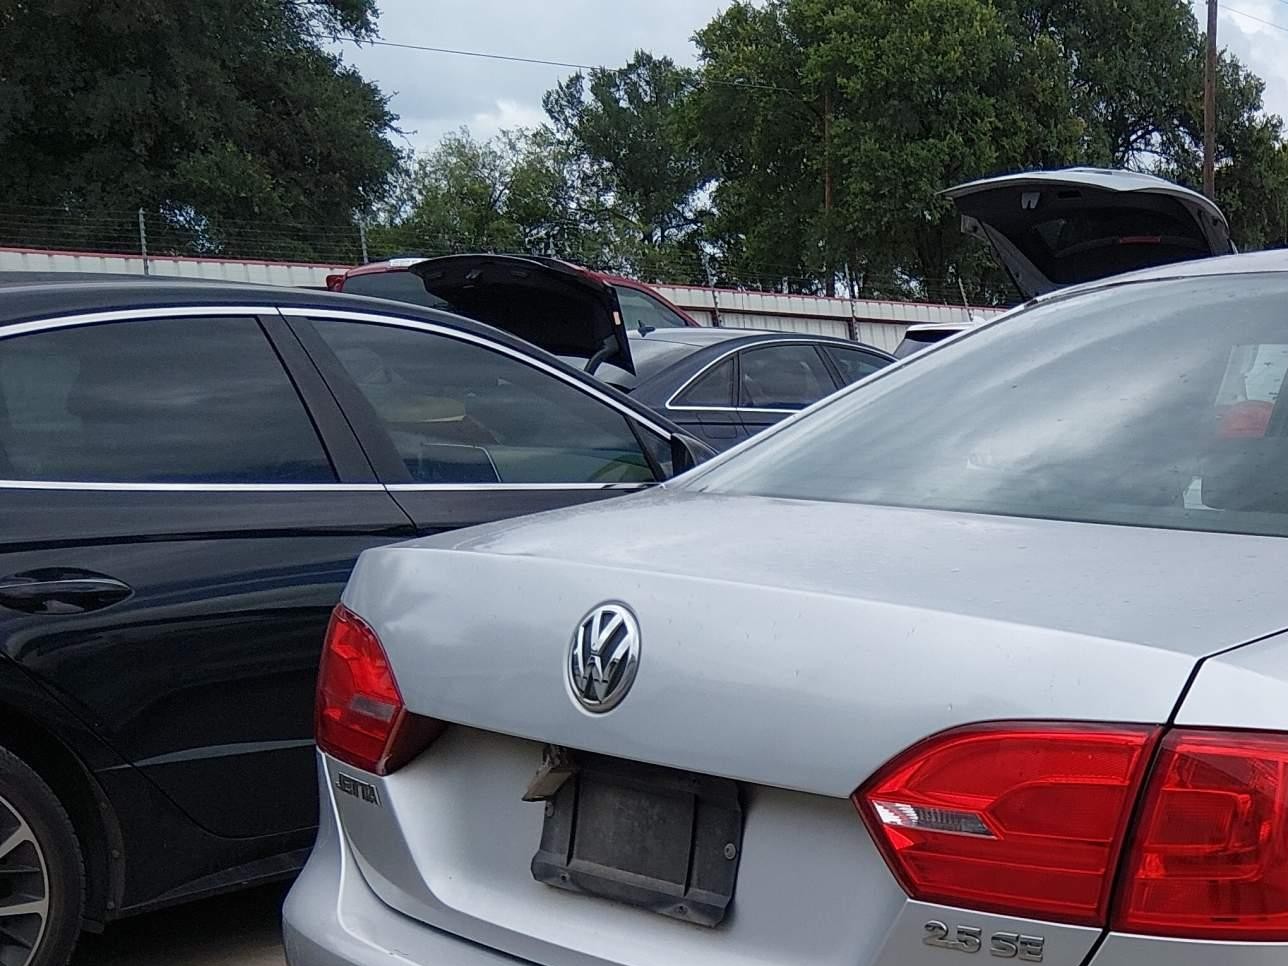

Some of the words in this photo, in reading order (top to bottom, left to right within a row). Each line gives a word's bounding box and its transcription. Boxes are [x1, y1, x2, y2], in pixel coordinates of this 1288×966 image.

[335, 771, 383, 808] JETTA
[923, 919, 982, 954] 2.5
[990, 931, 1045, 963] SE
